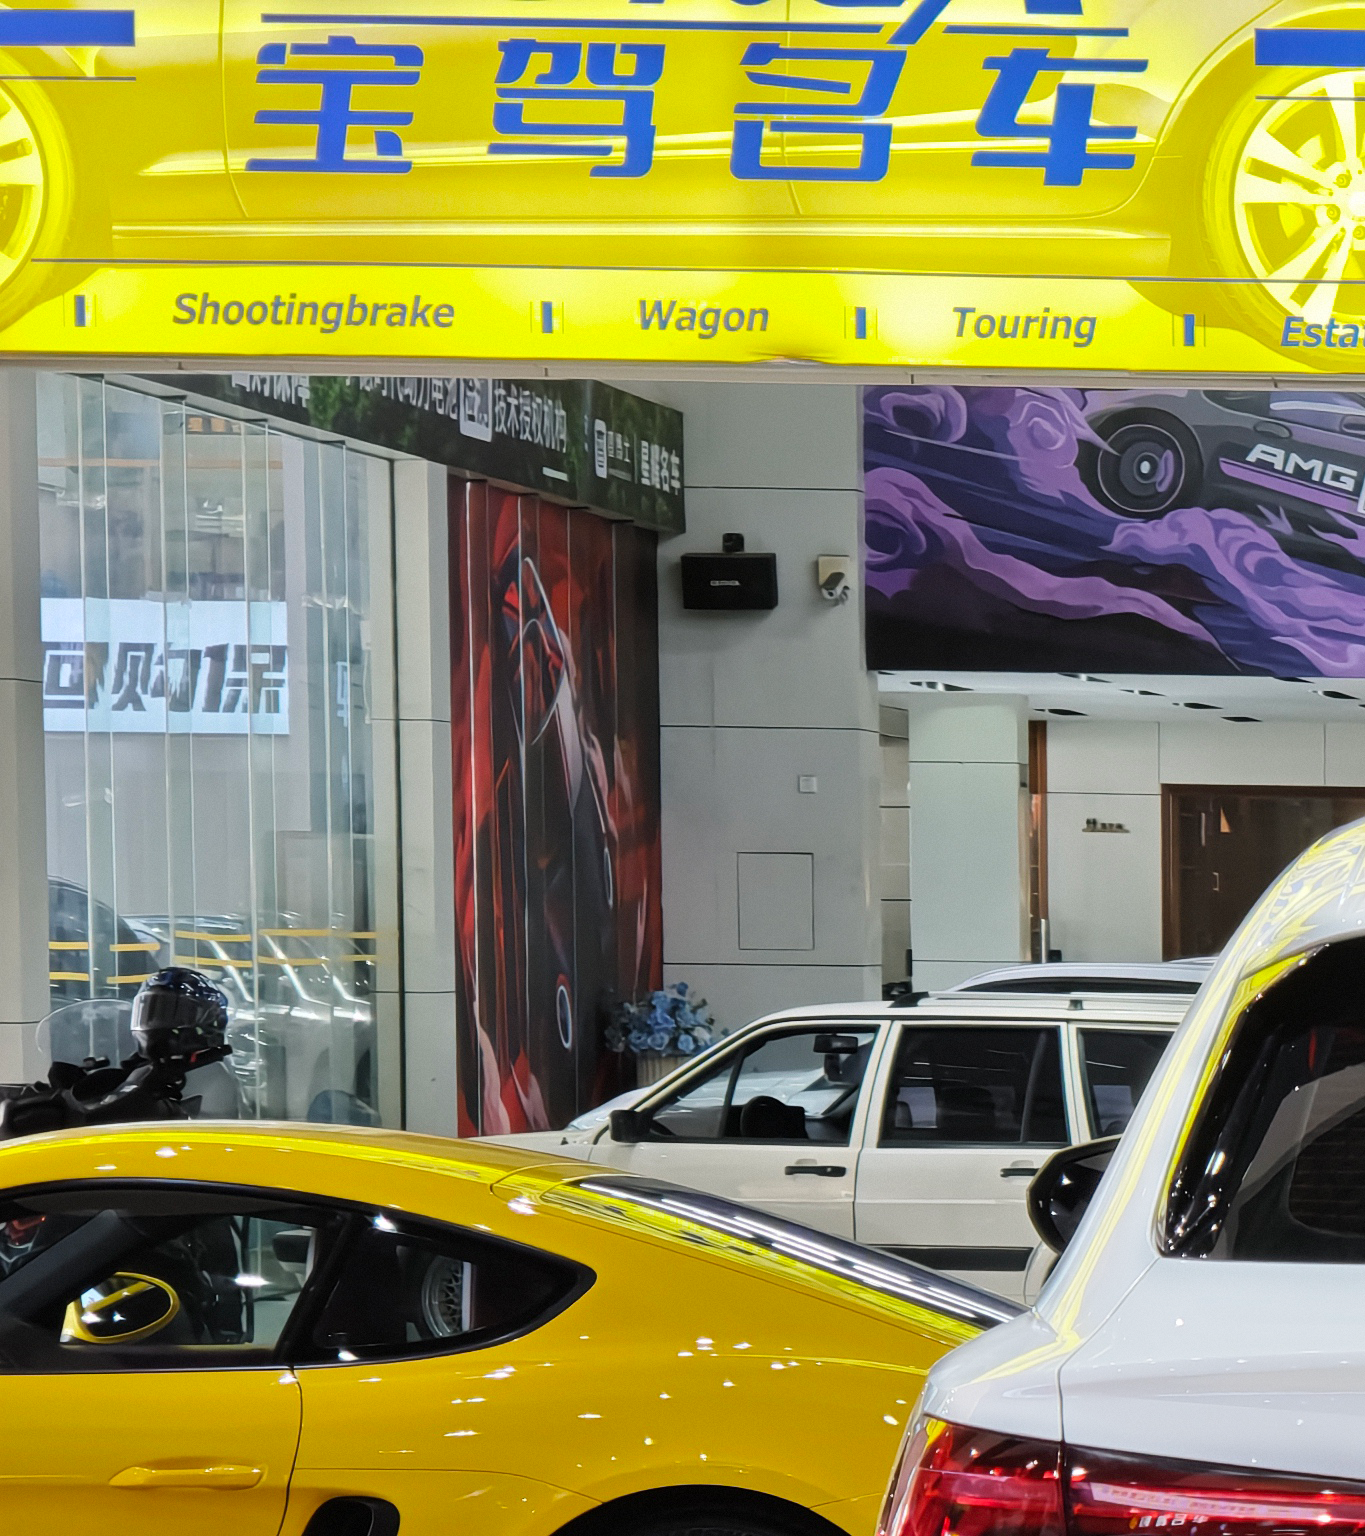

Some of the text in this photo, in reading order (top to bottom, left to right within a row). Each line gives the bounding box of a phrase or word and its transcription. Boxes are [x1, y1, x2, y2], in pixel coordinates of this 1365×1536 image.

[171, 292, 457, 335] Shootingbrake
[637, 299, 771, 339] Wagon
[952, 306, 1098, 348] Touring
[1245, 443, 1358, 492] AMG
